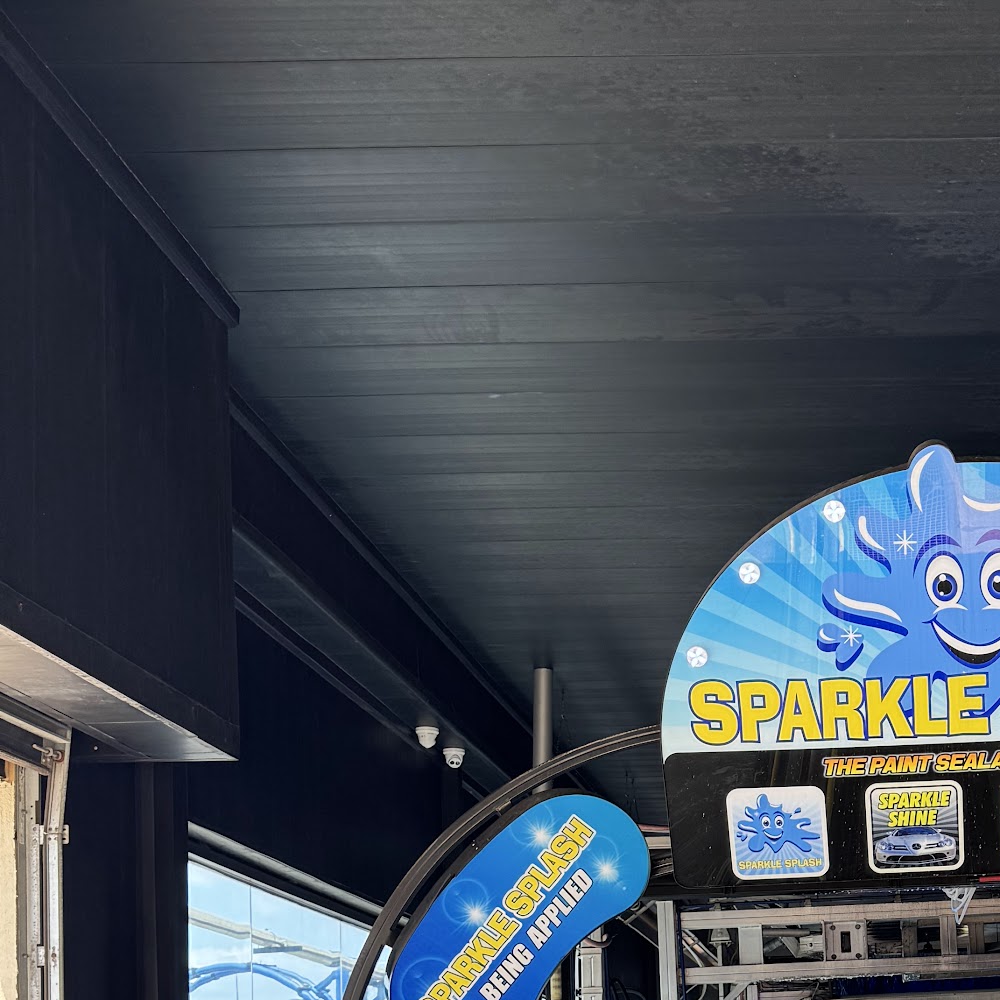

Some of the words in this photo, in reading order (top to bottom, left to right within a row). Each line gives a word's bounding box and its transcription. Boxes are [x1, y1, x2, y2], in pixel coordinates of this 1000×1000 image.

[689, 671, 991, 746] SPARKLE
[822, 756, 868, 778] THE
[868, 754, 934, 776] PAINT
[878, 790, 951, 810] SPARKLE
[888, 809, 938, 827] SHINE
[502, 813, 597, 920] SPLASH
[738, 859, 783, 870] SPARKLE
[784, 858, 822, 869] SPLASH
[525, 868, 594, 950] APPLIED
